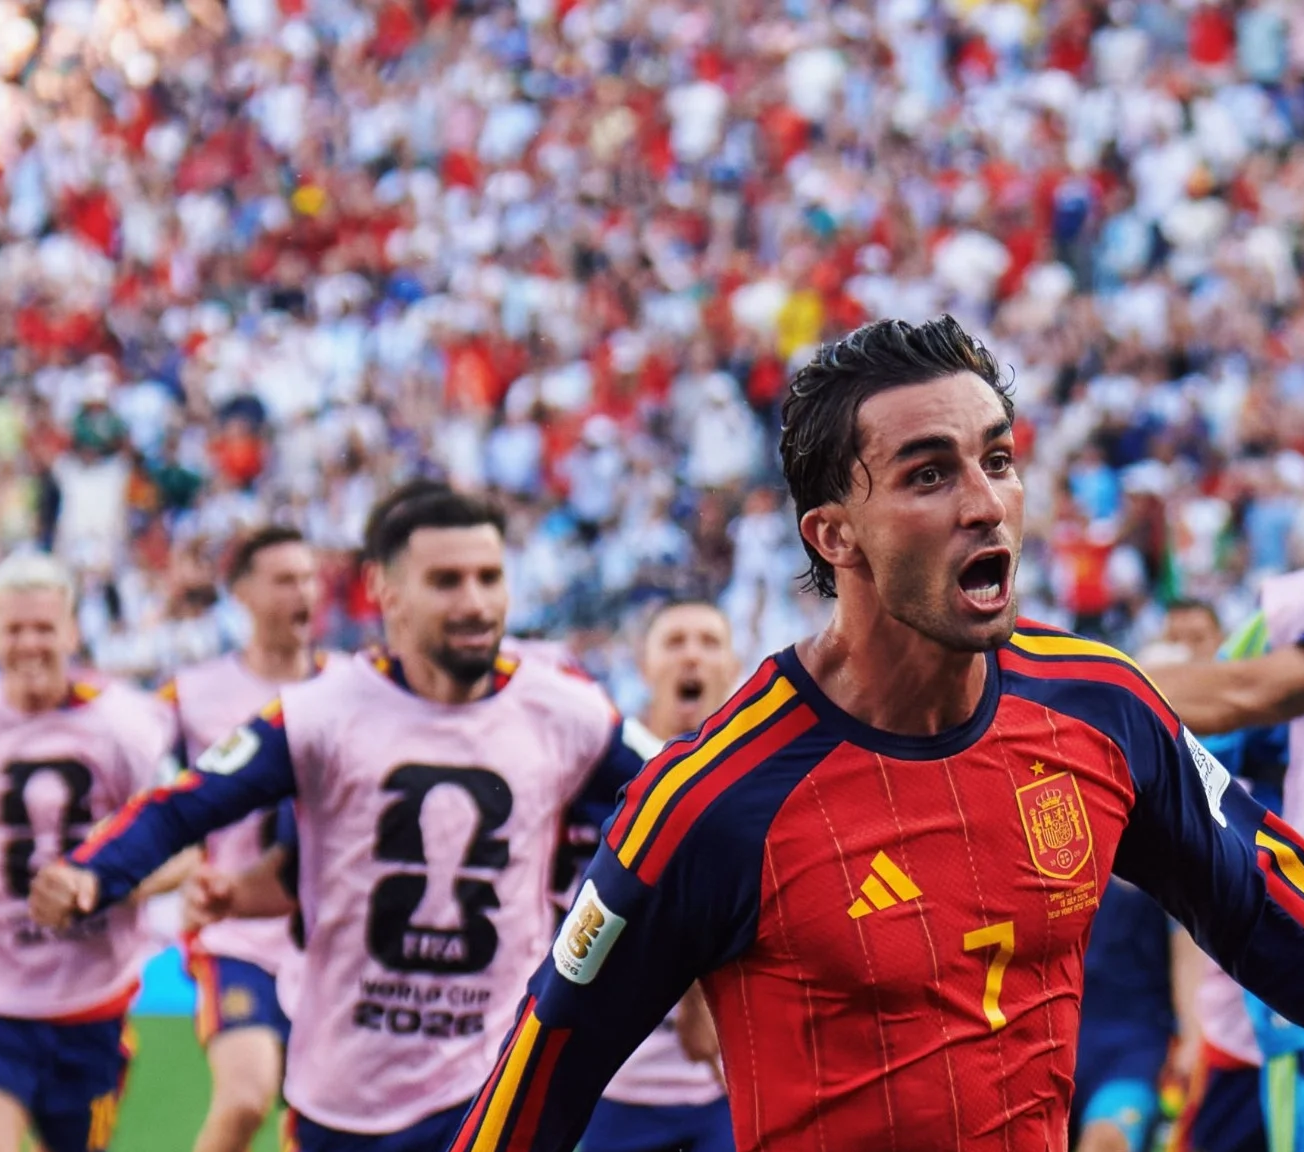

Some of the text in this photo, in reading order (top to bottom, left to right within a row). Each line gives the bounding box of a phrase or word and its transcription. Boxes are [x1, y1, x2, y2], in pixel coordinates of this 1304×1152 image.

[402, 932, 465, 962] FIFA
[963, 920, 1015, 1031] 7
[363, 980, 492, 1006] WORLD CUP
[352, 1000, 485, 1039] 2026
